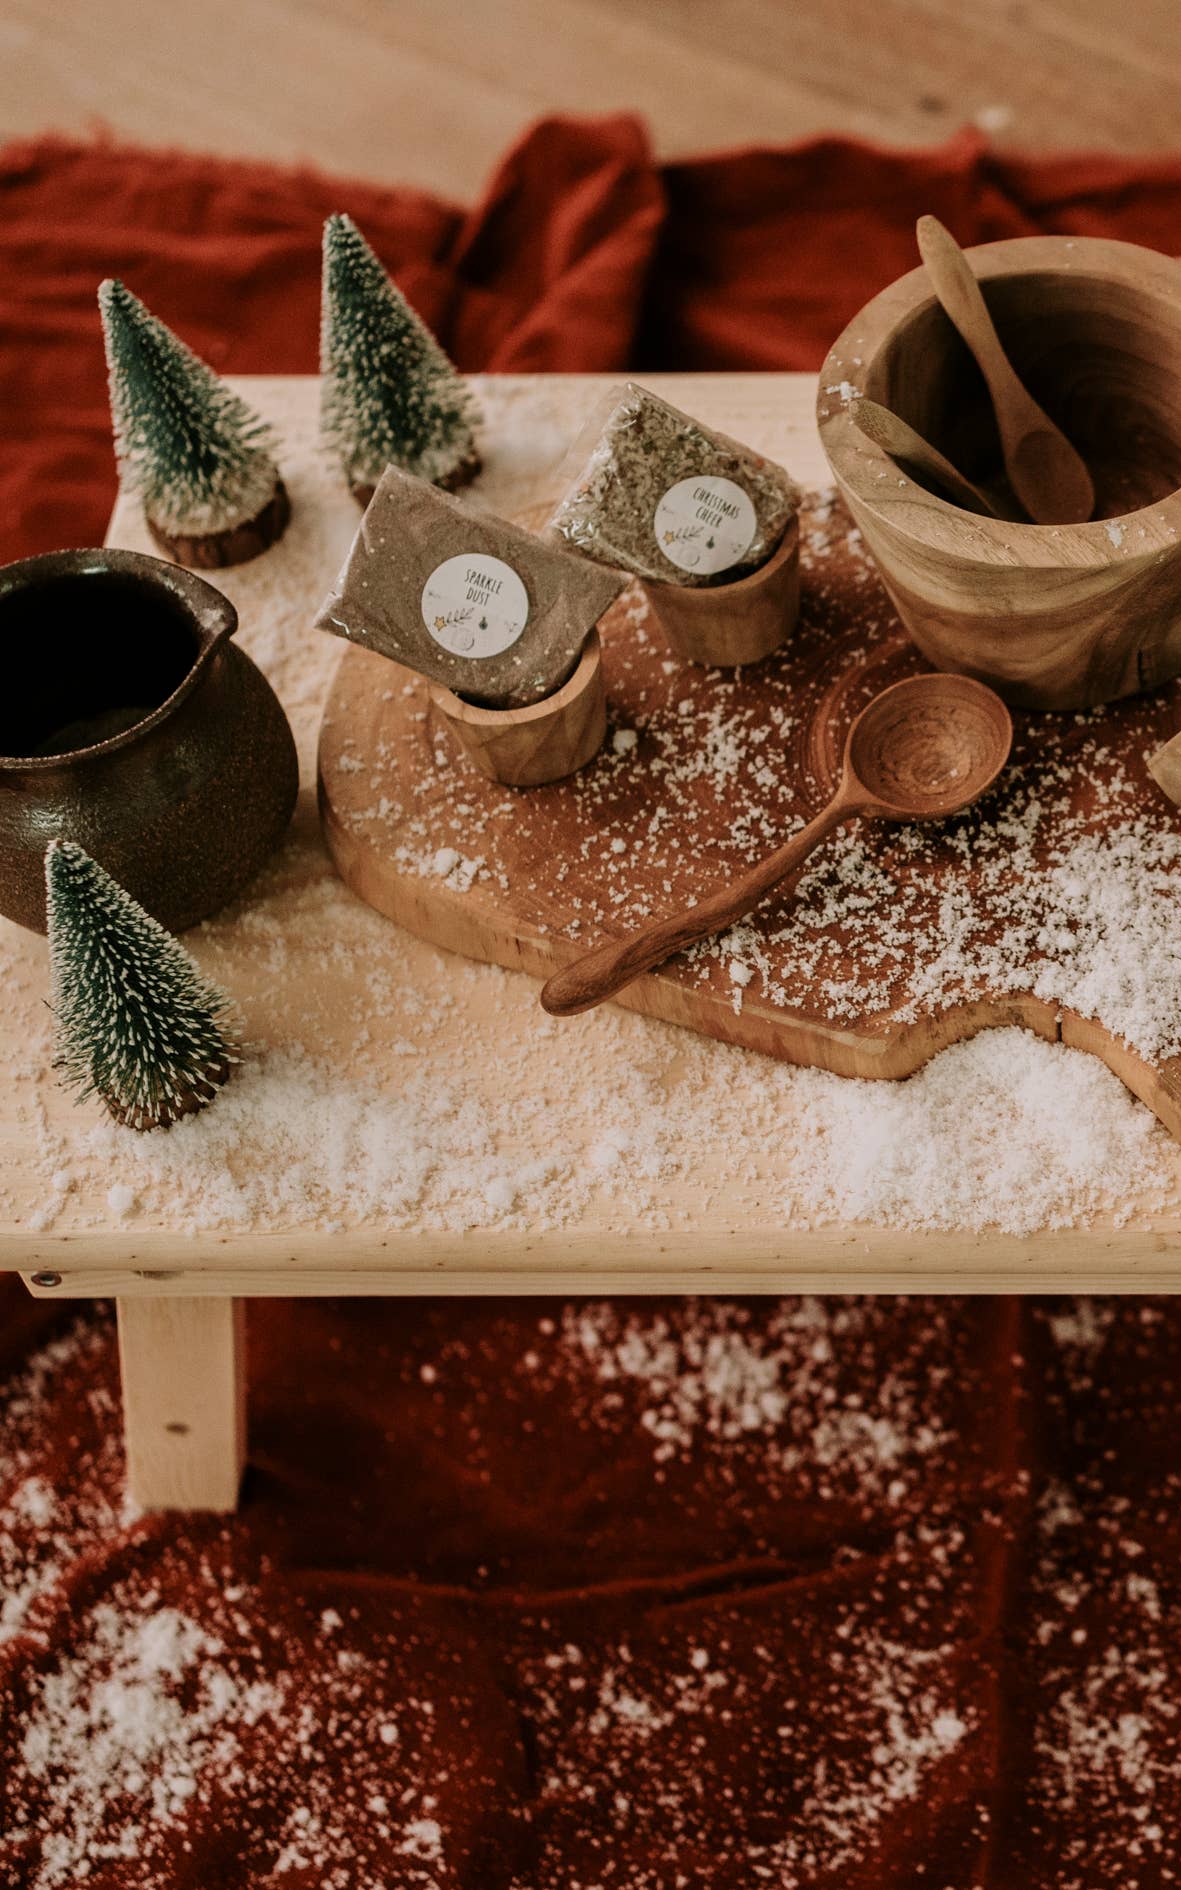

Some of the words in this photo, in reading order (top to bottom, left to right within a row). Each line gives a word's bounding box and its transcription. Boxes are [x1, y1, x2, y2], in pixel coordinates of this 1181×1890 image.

[693, 487, 741, 520] CHRISTMAS
[696, 506, 724, 529] CHEER
[463, 568, 504, 595] SPARKLE
[466, 589, 491, 606] DUST
